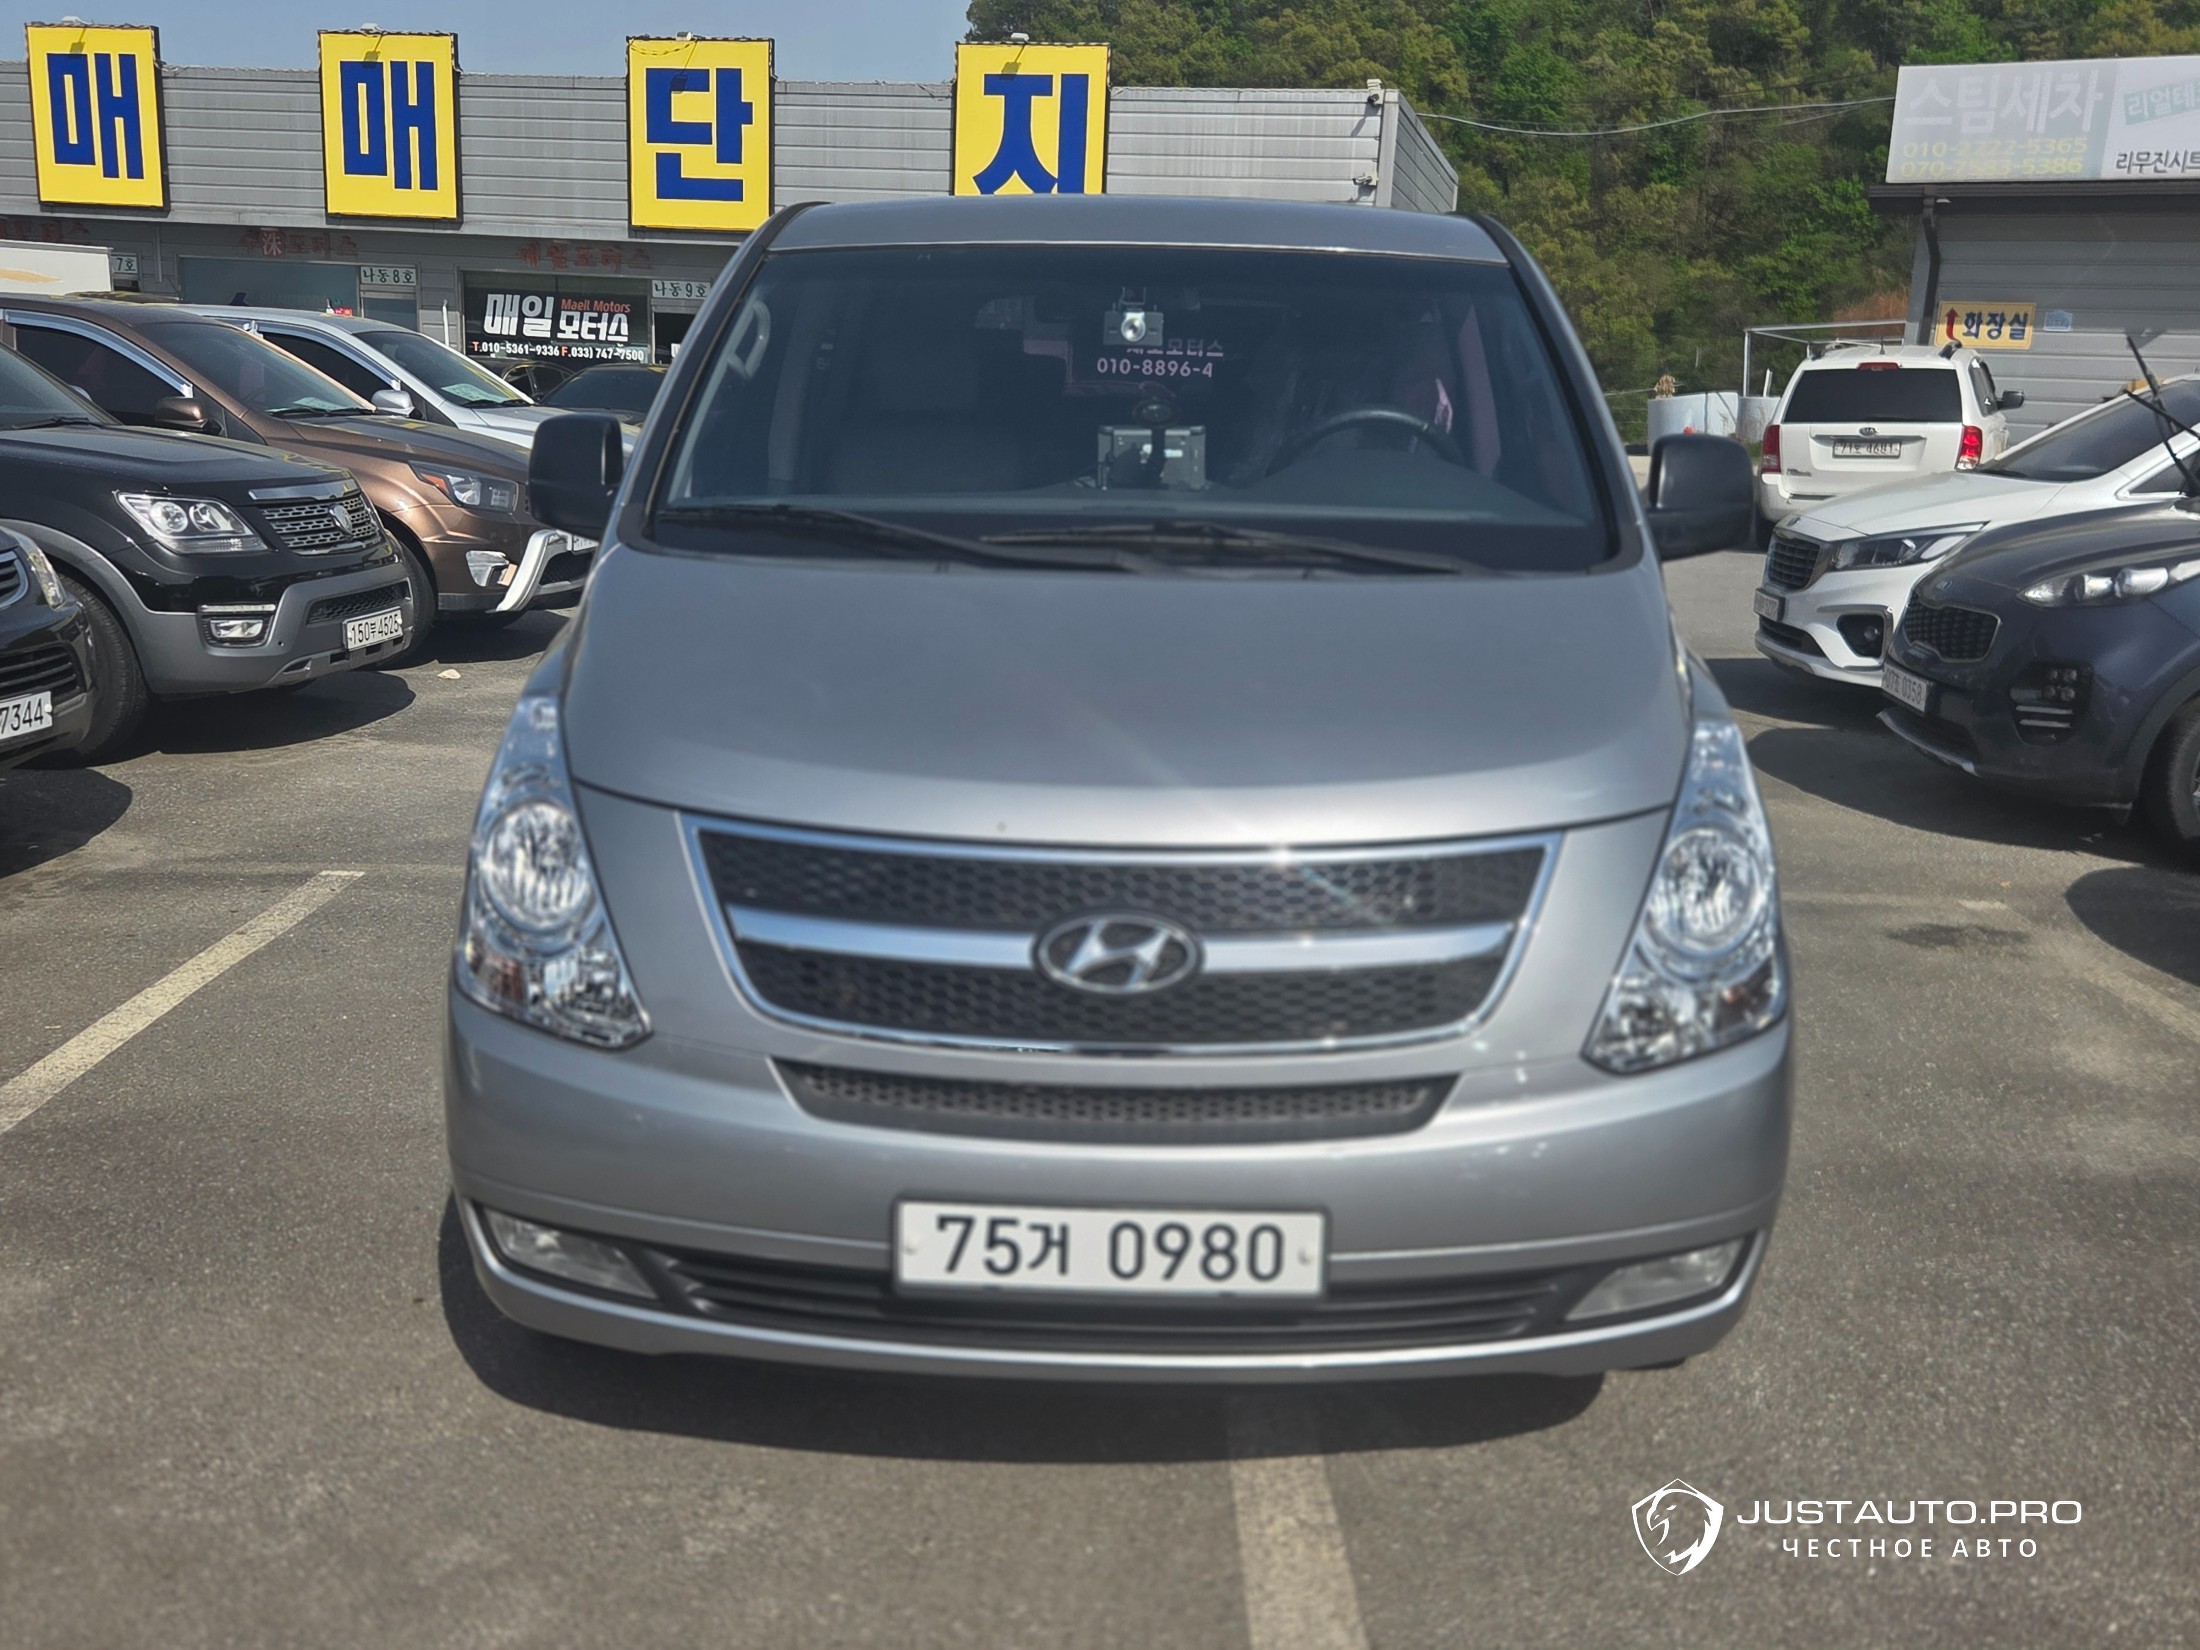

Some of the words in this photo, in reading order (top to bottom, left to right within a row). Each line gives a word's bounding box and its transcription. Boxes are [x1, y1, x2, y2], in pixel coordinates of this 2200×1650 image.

[1903, 69, 2104, 134] 스팀세차
[44, 52, 145, 180] 매
[338, 60, 438, 191] 매
[645, 67, 753, 203] 단
[972, 72, 1089, 194] 지
[362, 268, 416, 285] 나동8호
[654, 281, 707, 298] 나동9호
[483, 294, 555, 338] 매일
[557, 311, 629, 342] 모터스
[593, 301, 631, 313] Motors
[1962, 311, 2028, 341] 화장실
[936, 1214, 1070, 1276] 75거
[1108, 1219, 1285, 1282] 0980
